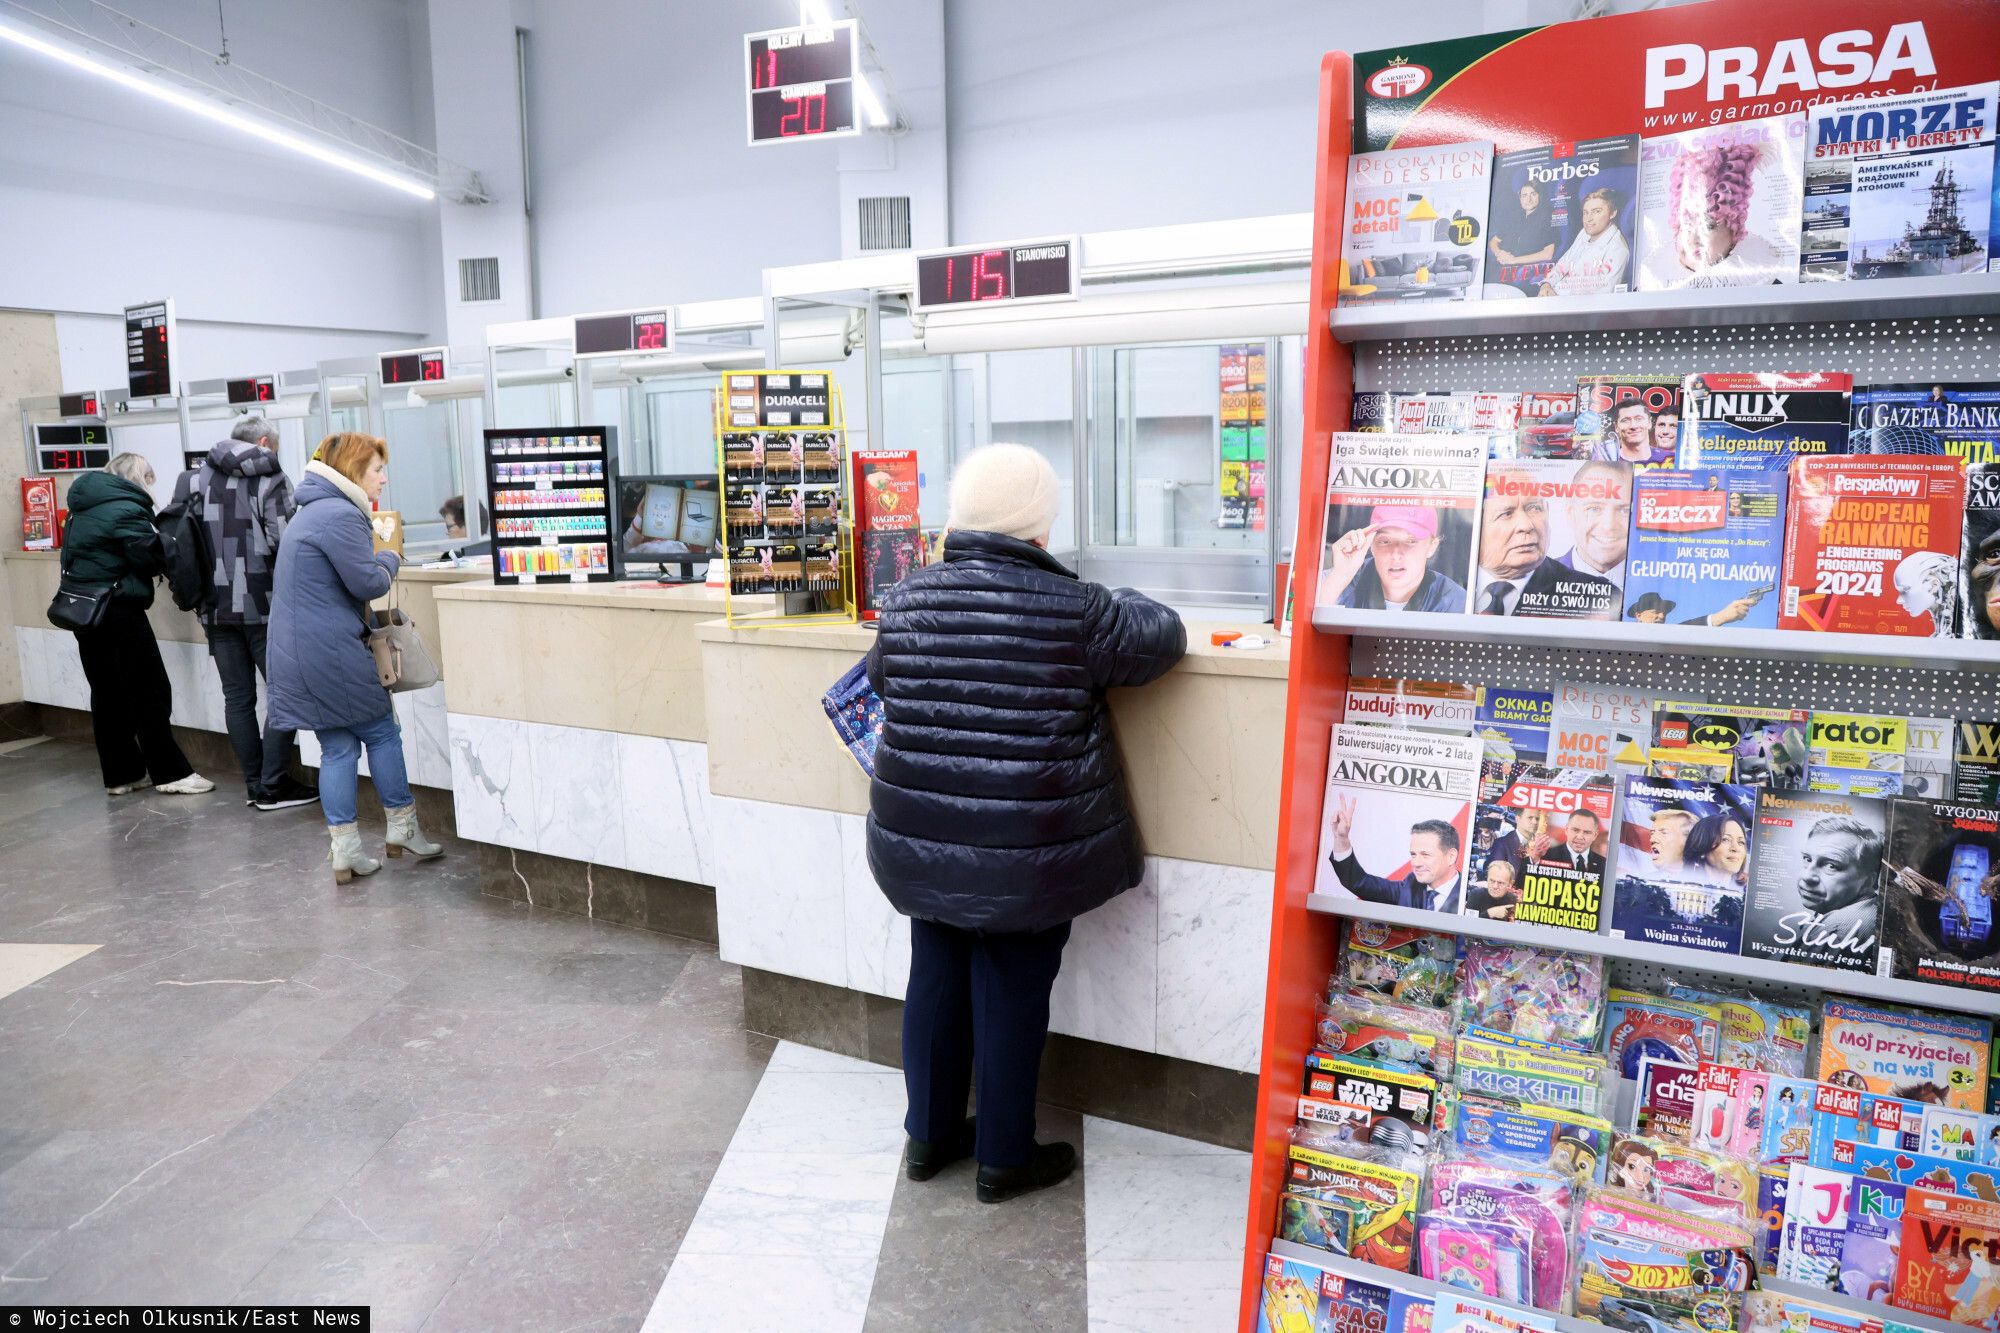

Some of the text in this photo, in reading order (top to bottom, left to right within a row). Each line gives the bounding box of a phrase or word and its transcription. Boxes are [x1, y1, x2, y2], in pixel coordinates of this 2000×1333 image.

[1644, 20, 1937, 109] PRASA
[1380, 73, 1416, 83] GARMOND
[780, 94, 827, 137] 20
[1818, 98, 1986, 146] MORZE
[1815, 139, 1881, 158] STATKI
[1890, 136, 1898, 151] I
[1906, 126, 1984, 149] OKRĘTY
[1356, 150, 1485, 173] DECORATION
[1857, 159, 1934, 174] AMERYKAŃSKIE
[1383, 163, 1483, 184] DESIGN
[1526, 161, 1600, 183] Forbes
[1857, 170, 1919, 183] KRĄŻOWNIKI
[1857, 181, 1905, 192] ATOMOWE
[1353, 198, 1400, 219] MOC
[1352, 217, 1399, 235] detali
[1015, 245, 1067, 263] STANOWISKO
[634, 313, 666, 325] STANOWISKO
[637, 324, 667, 350] 22
[423, 361, 444, 380] 21
[85, 399, 97, 415] 19
[765, 395, 826, 406] DURACELL
[1222, 397, 1248, 408] 8200
[1874, 403, 1941, 428] GAZETA
[85, 431, 95, 445] 2
[766, 441, 791, 449] DURACELL
[805, 441, 829, 449] DURACELL
[1788, 436, 1827, 453] dom
[858, 450, 910, 460] POLECAMY
[1336, 442, 1480, 459] Iga Świątek niewinna?
[1332, 466, 1447, 489] ANGORA
[1833, 474, 1920, 497] Perspektywy
[896, 485, 909, 493] LIS
[1485, 473, 1622, 500] Newsweek
[767, 497, 792, 505] DURACELL
[1347, 496, 1456, 506] MAM ZŁAMANE SERCE
[1640, 497, 1656, 506] DO
[871, 514, 913, 524] MAGICZNY
[1639, 504, 1722, 524] RZECZY
[1818, 521, 1929, 548] RANKING
[730, 557, 760, 565] DURACELL
[1676, 546, 1730, 560] JAK SIĘ GRA
[1826, 546, 1903, 560] ENGINEERING
[1630, 560, 1777, 583] GŁUPOTĄ POLAKÓW
[1816, 558, 1884, 573] PROGRAMS
[1555, 581, 1612, 596] KACZYŃSKI
[1814, 571, 1883, 597] 2024
[1522, 592, 1610, 609] DRŻY O SWÓJ LOS
[1495, 697, 1538, 711] OKNA
[1493, 710, 1530, 722] BRAMY
[1662, 728, 1688, 740] LEGO
[1811, 721, 1895, 746] rator
[1337, 735, 1474, 761] Bulwersujący wyrok 2 lata
[1558, 731, 1609, 754] MOC
[1556, 752, 1607, 770] detali
[1333, 759, 1444, 791] ANGORA
[1511, 785, 1583, 814] SIECI
[1630, 780, 1716, 803] Newsweek
[1762, 793, 1853, 816] Newsweek
[1526, 863, 1582, 879] TAK SYSTEM TUSKA
[1522, 874, 1601, 913] DOPAŚĆ
[1515, 902, 1598, 931] NAWROCKIEGO
[1644, 927, 1729, 949] Wojna światów
[1751, 941, 1862, 966] Wszystkie role jego
[1918, 957, 1968, 971] Jak władza
[1917, 967, 1964, 982] POLSKIE
[1624, 1006, 1696, 1031] KACZOR
[1838, 1030, 1971, 1066] Mój przyjaciel
[1873, 1061, 1935, 1079] na wsi
[1311, 1081, 1333, 1091] LEGO
[1338, 1079, 1394, 1100] STAR
[1338, 1090, 1393, 1111] WARS
[1832, 1089, 1859, 1113] Fakt
[1315, 1107, 1342, 1117] STAR
[1315, 1113, 1342, 1122] WARS
[1873, 1100, 1900, 1123] Fakt
[1497, 1122, 1548, 1136] WALKIE-TALKIE
[1505, 1131, 1544, 1143] SPORTOWY
[1505, 1139, 1537, 1149] ZEGAREK
[1832, 1149, 1854, 1164] Fakt
[1955, 1202, 1973, 1212] DO
[1268, 1259, 1283, 1273] Fakt
[1322, 1271, 1345, 1295] Fakt
[1455, 1303, 1481, 1316] Nasza
